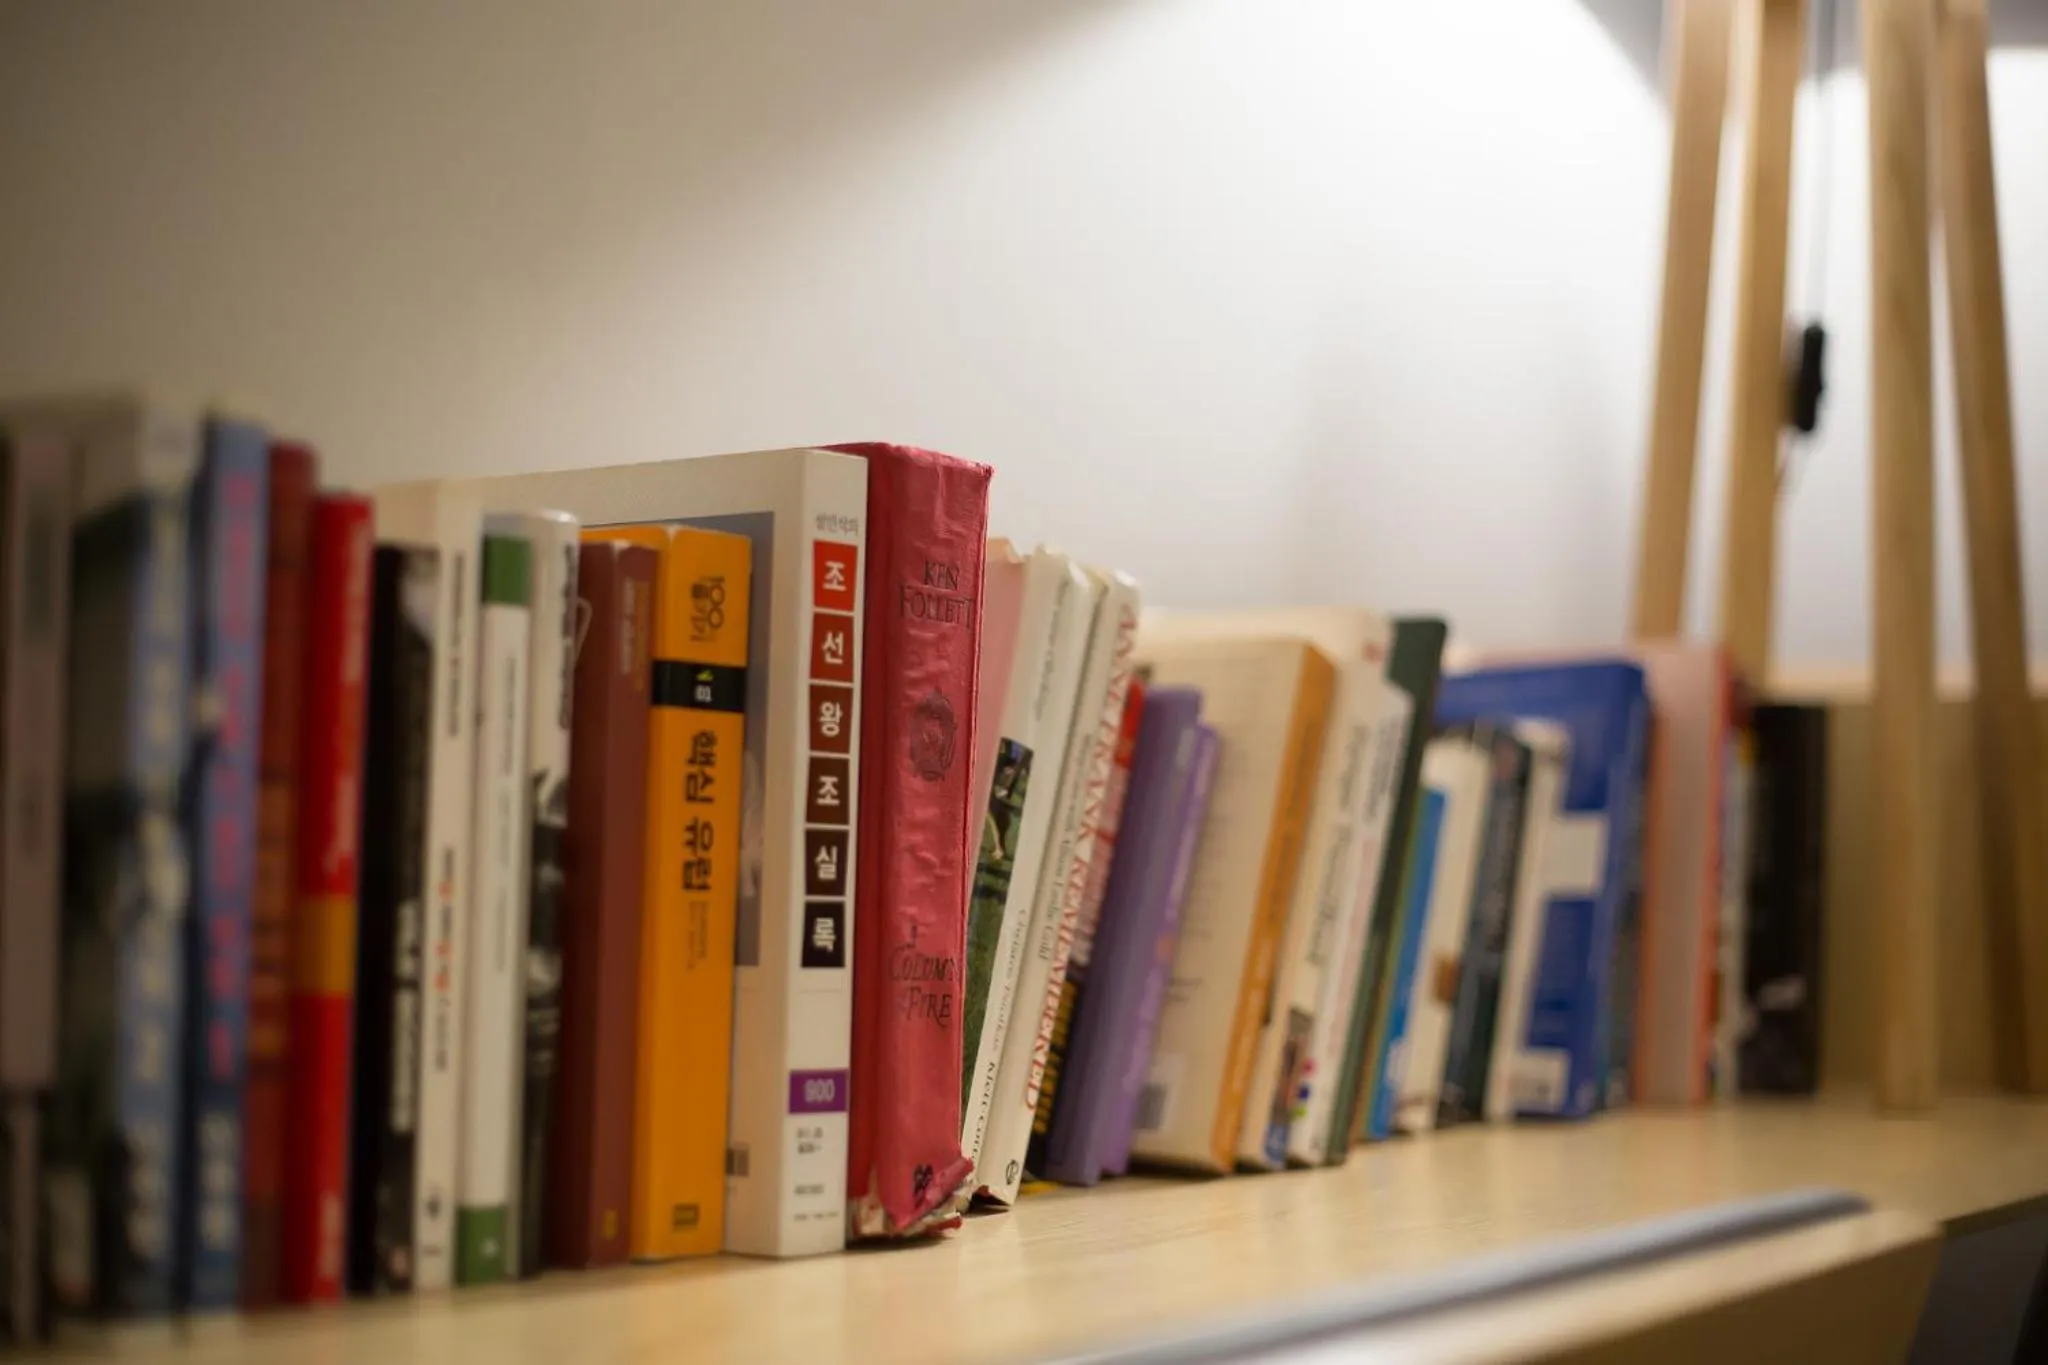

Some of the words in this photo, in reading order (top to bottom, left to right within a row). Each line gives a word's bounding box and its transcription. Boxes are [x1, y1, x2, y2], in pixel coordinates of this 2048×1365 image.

[899, 582, 974, 630] FOLLETT
[923, 558, 961, 591] KEN
[685, 730, 718, 804] 핵심
[813, 561, 847, 952] 조선왕조실록
[682, 816, 715, 892] 유럽
